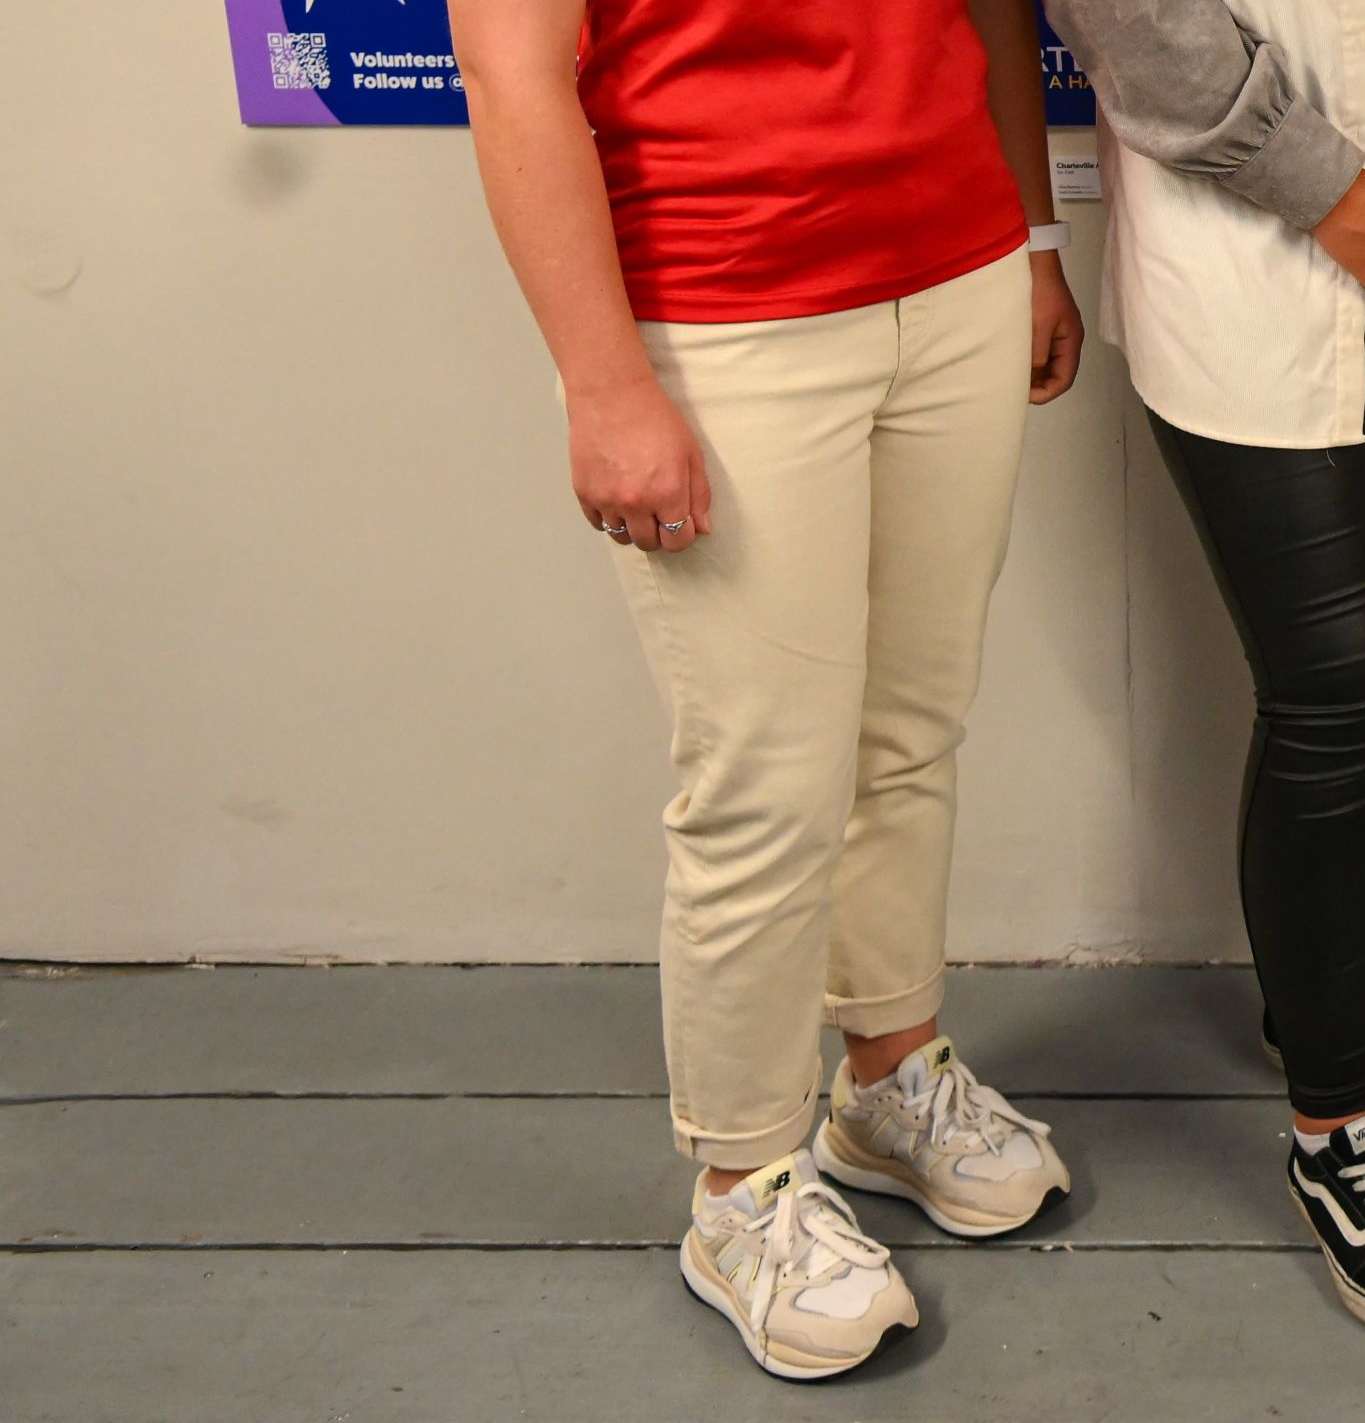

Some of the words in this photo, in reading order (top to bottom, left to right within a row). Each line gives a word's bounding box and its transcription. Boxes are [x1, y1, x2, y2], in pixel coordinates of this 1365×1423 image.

[350, 52, 454, 68] Volunteers
[353, 73, 416, 89] Follow
[422, 76, 443, 89] us
[1056, 162, 1094, 170] Charleville
